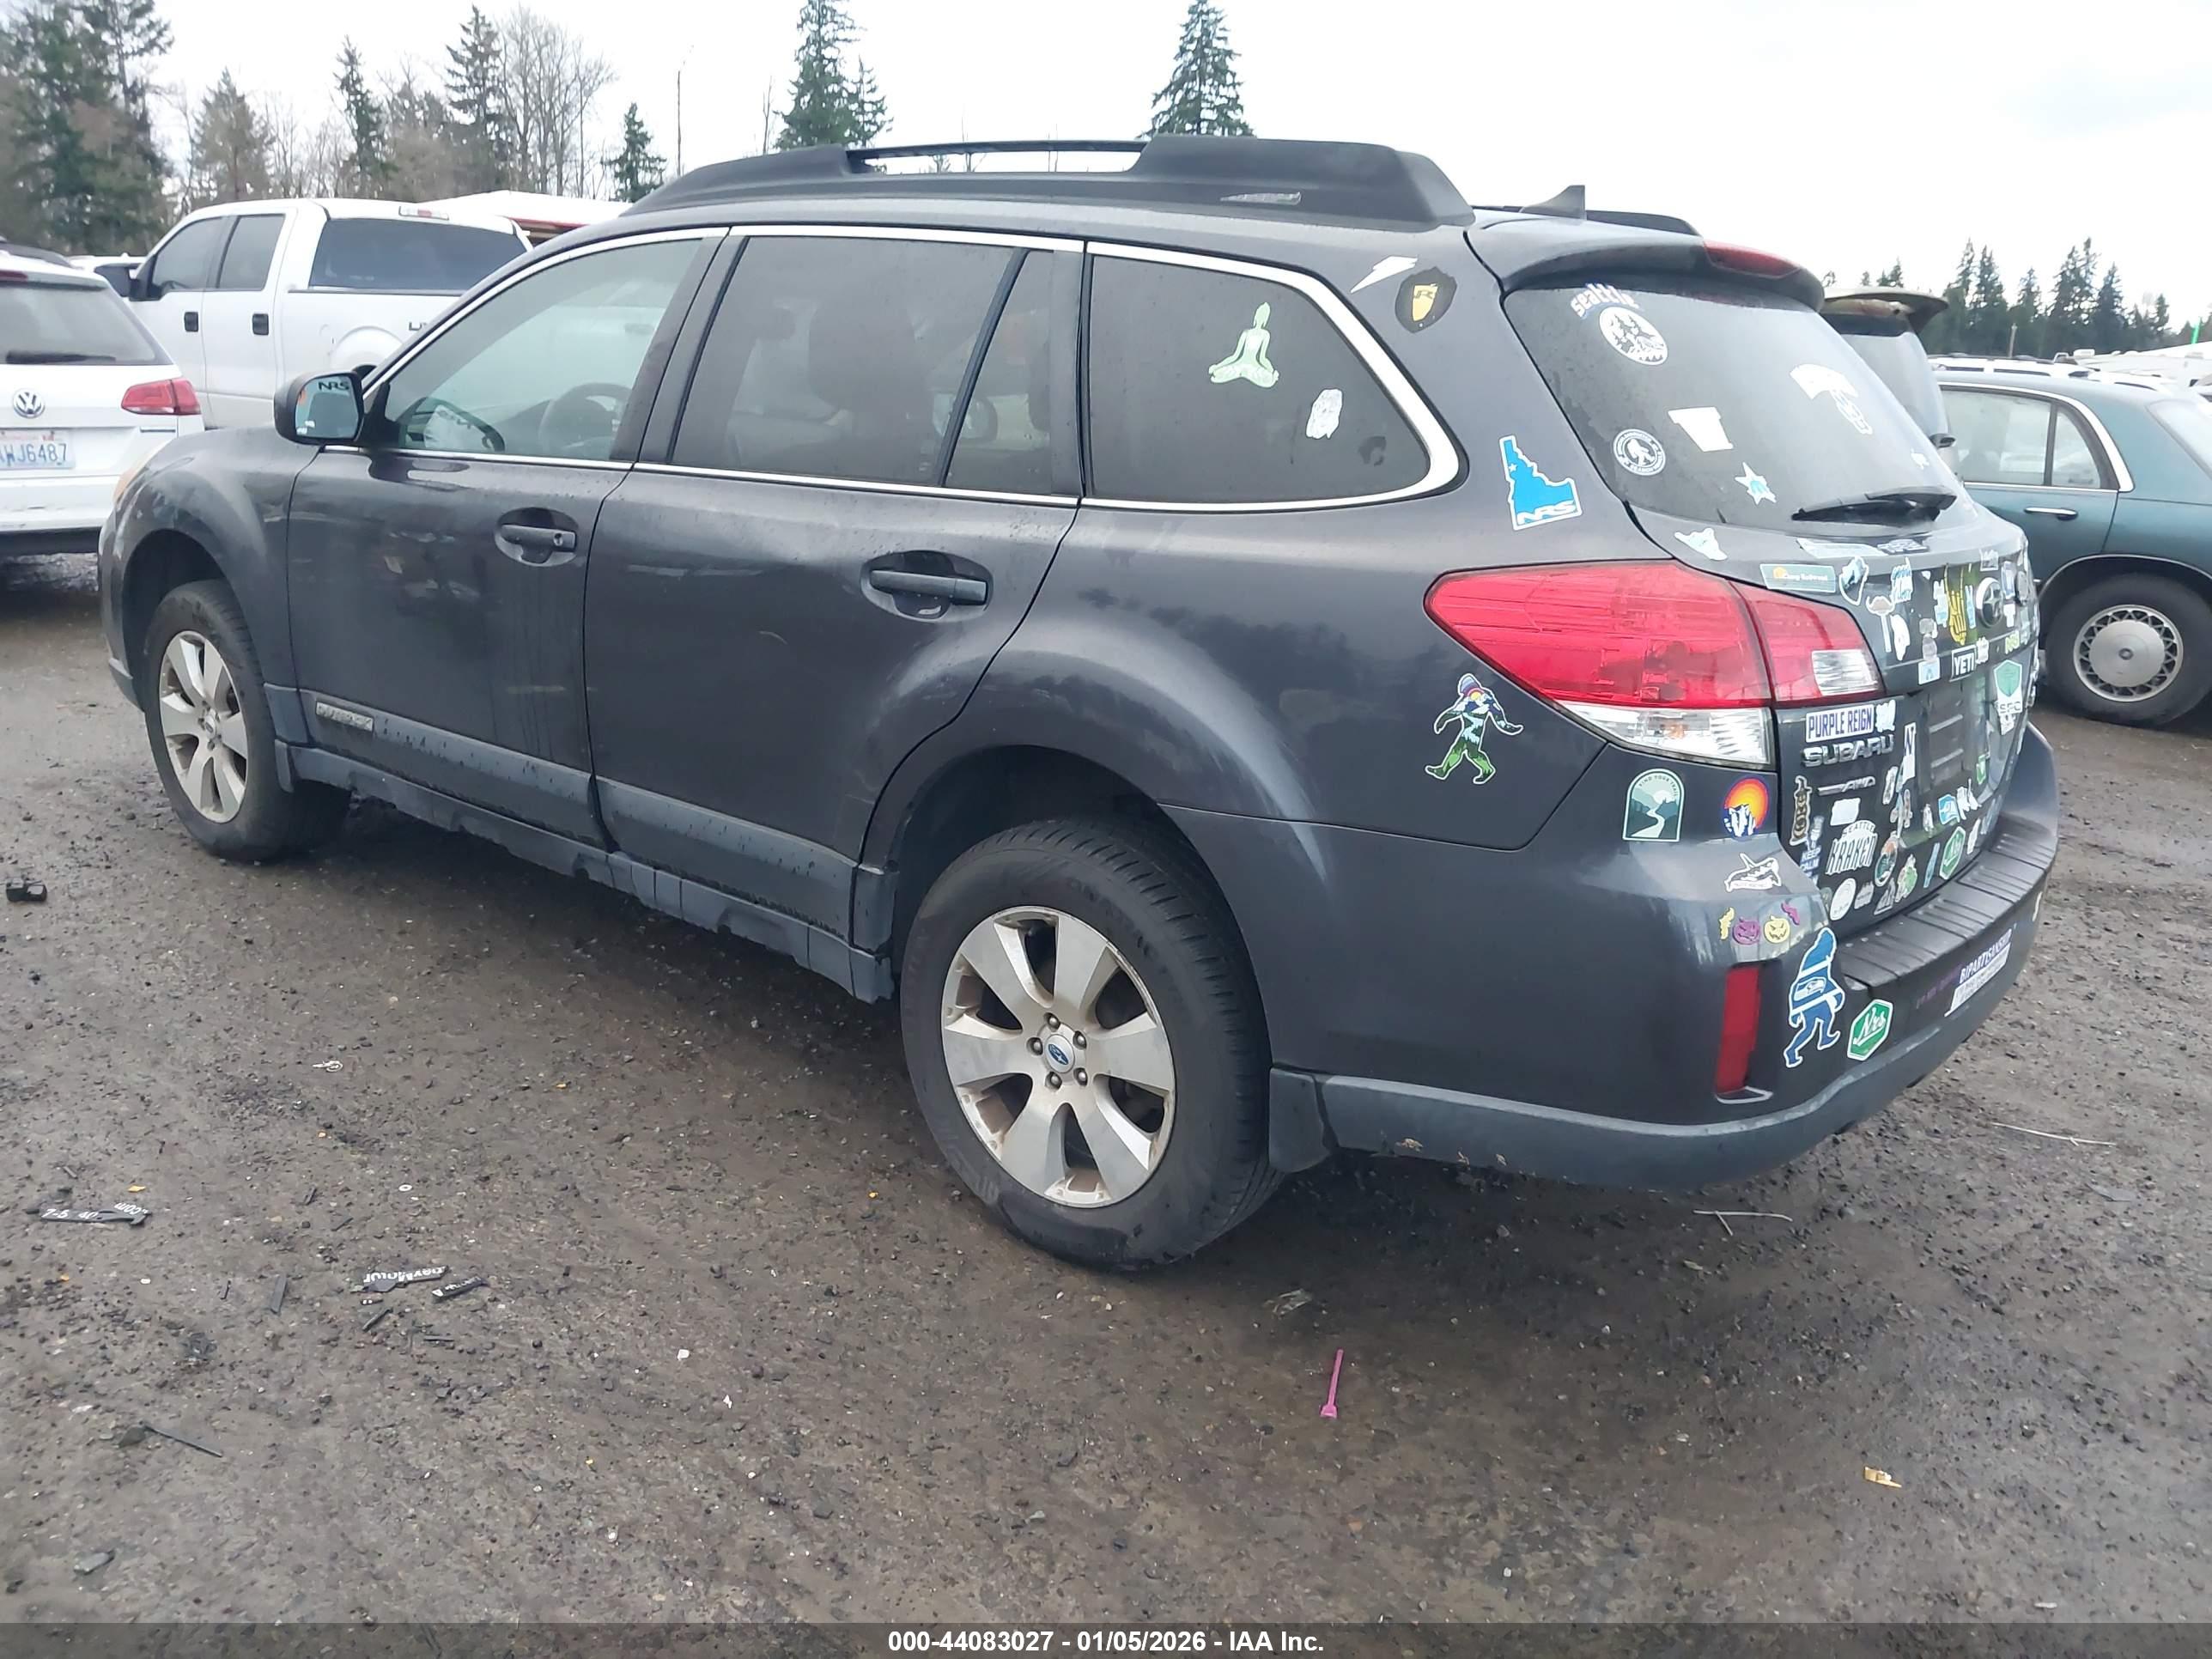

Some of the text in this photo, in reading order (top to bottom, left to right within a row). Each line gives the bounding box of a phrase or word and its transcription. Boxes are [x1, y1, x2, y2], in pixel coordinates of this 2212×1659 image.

[1954, 652, 1974, 675] YETI
[1808, 707, 1873, 739] PURPLE REIGN
[1802, 734, 1894, 767] SUBARU
[1825, 833, 1878, 875] KRAKEN
